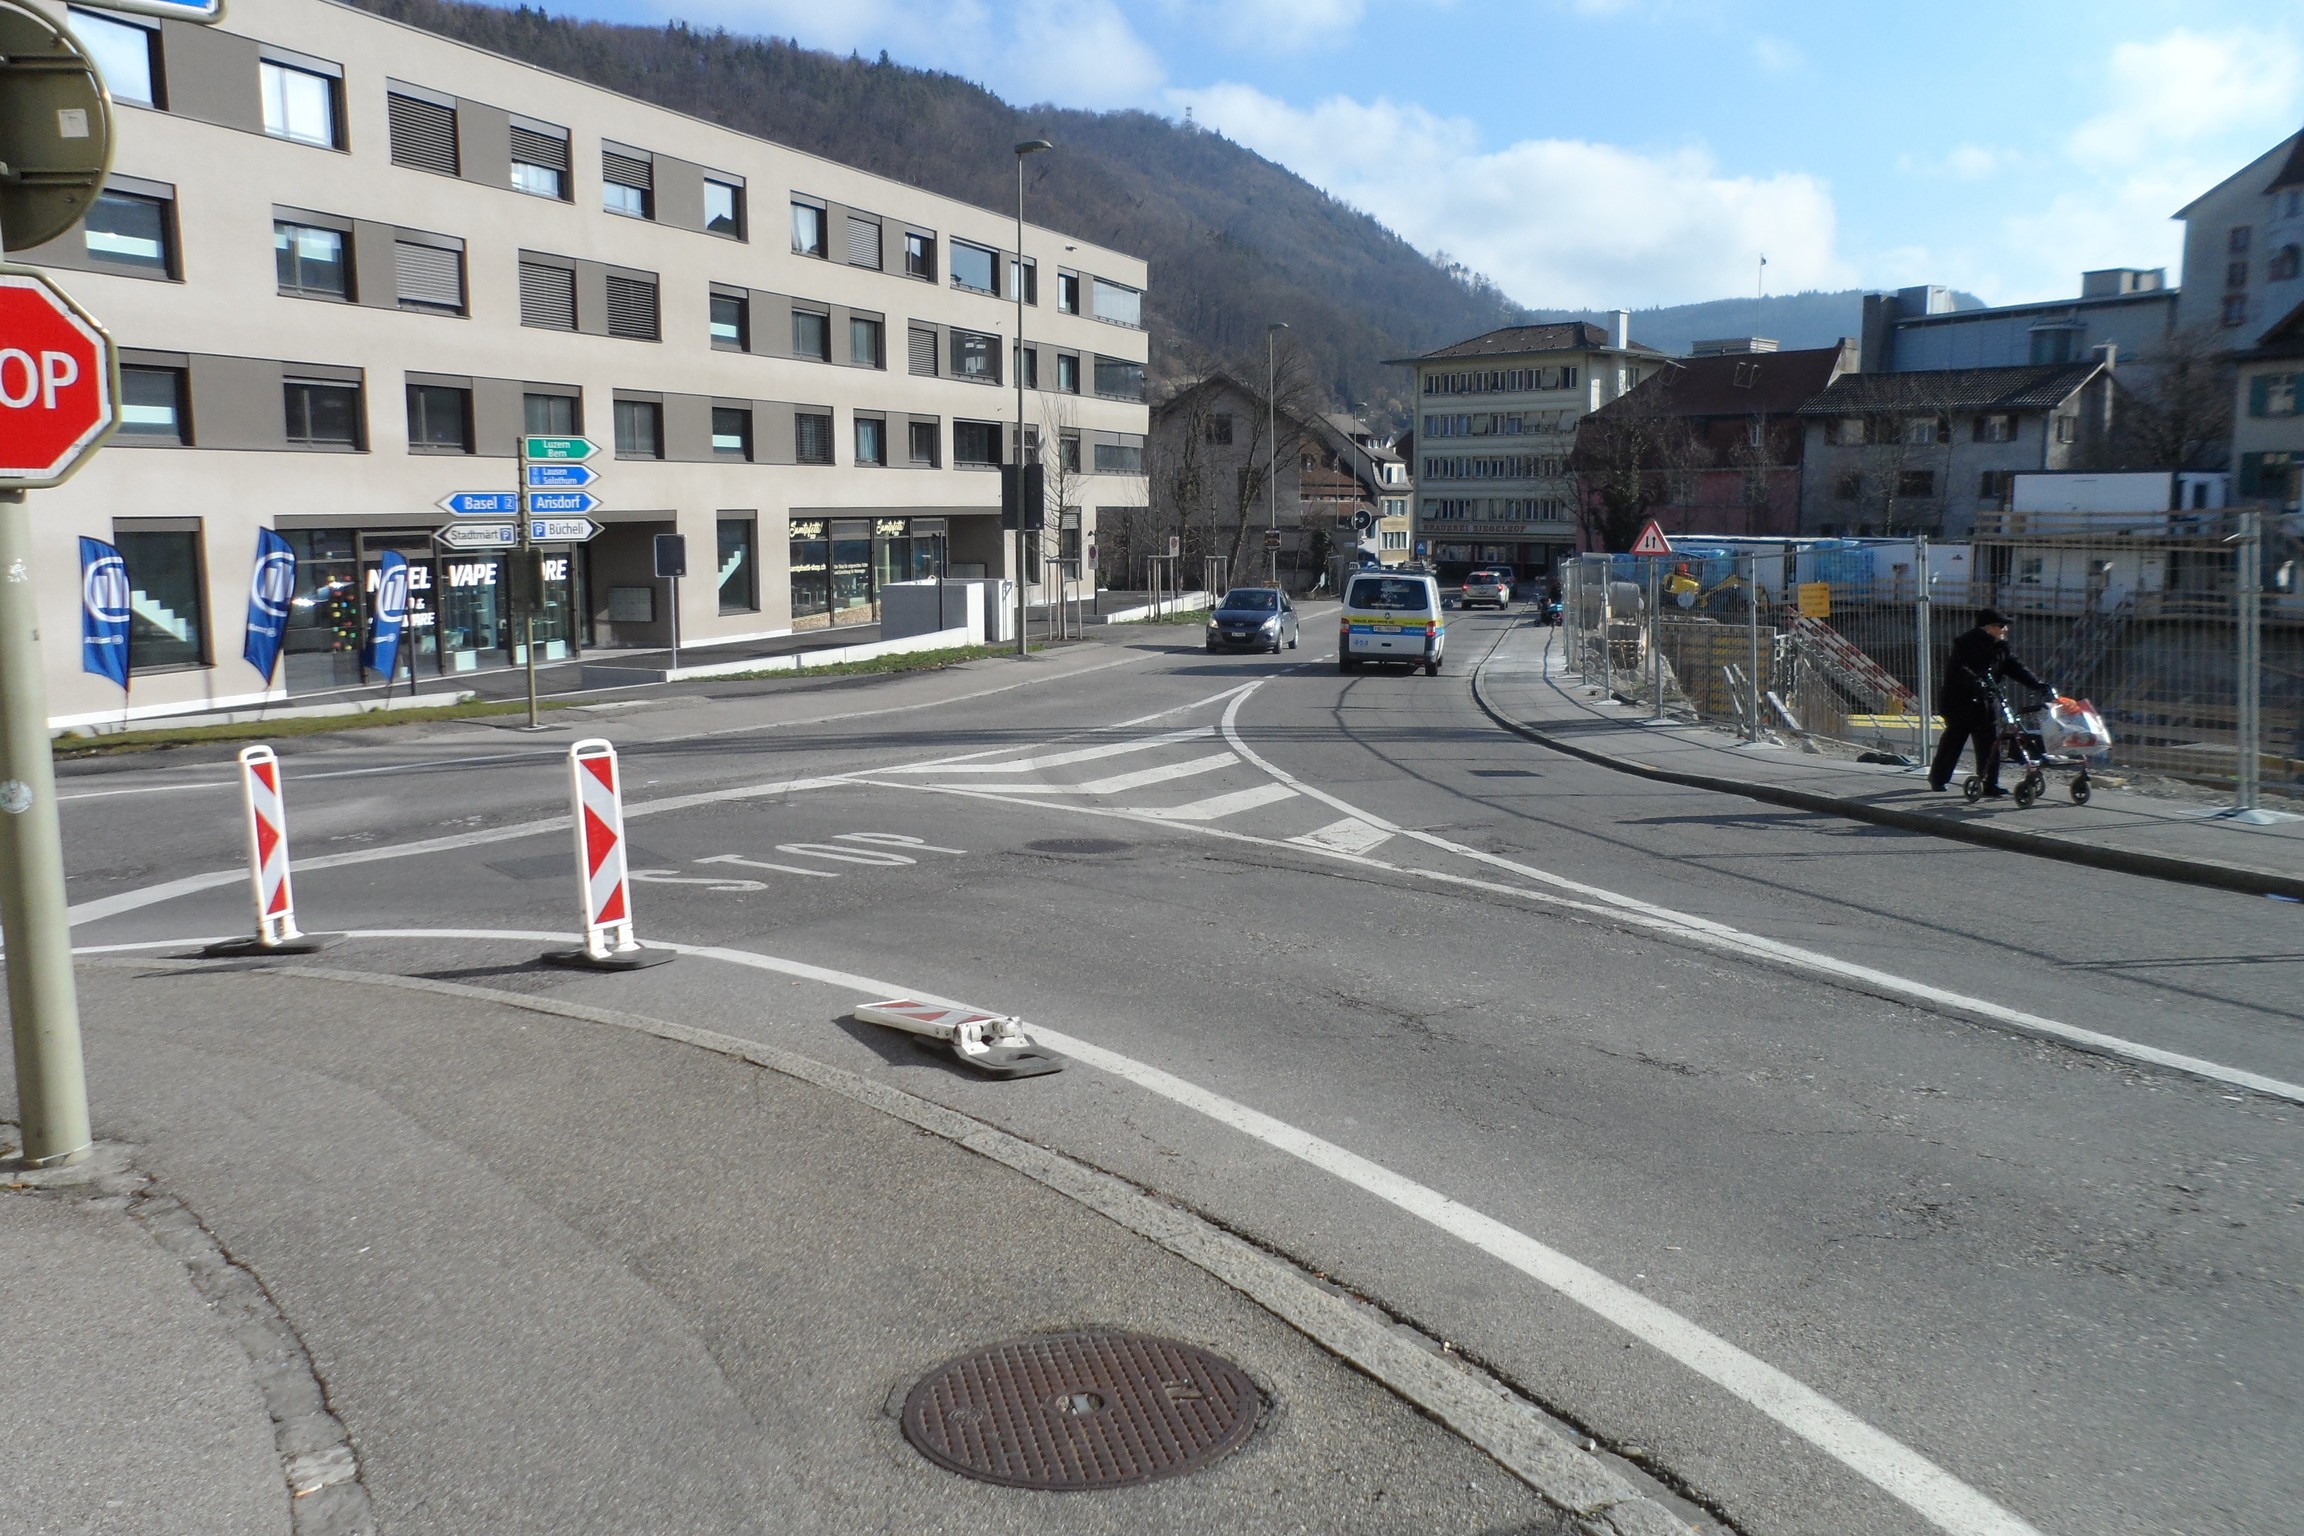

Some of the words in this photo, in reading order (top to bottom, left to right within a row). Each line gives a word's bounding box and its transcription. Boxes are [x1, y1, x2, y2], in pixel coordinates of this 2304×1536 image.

[0, 348, 78, 409] OP
[543, 440, 570, 448] Luzern
[548, 449, 567, 457] Bern
[464, 496, 498, 509] Basel
[536, 495, 580, 508] Arisdorf
[451, 530, 498, 540] Stadtmärt
[549, 522, 584, 535] Bücheli
[449, 563, 497, 588] VAPE
[627, 832, 968, 891] STOP
